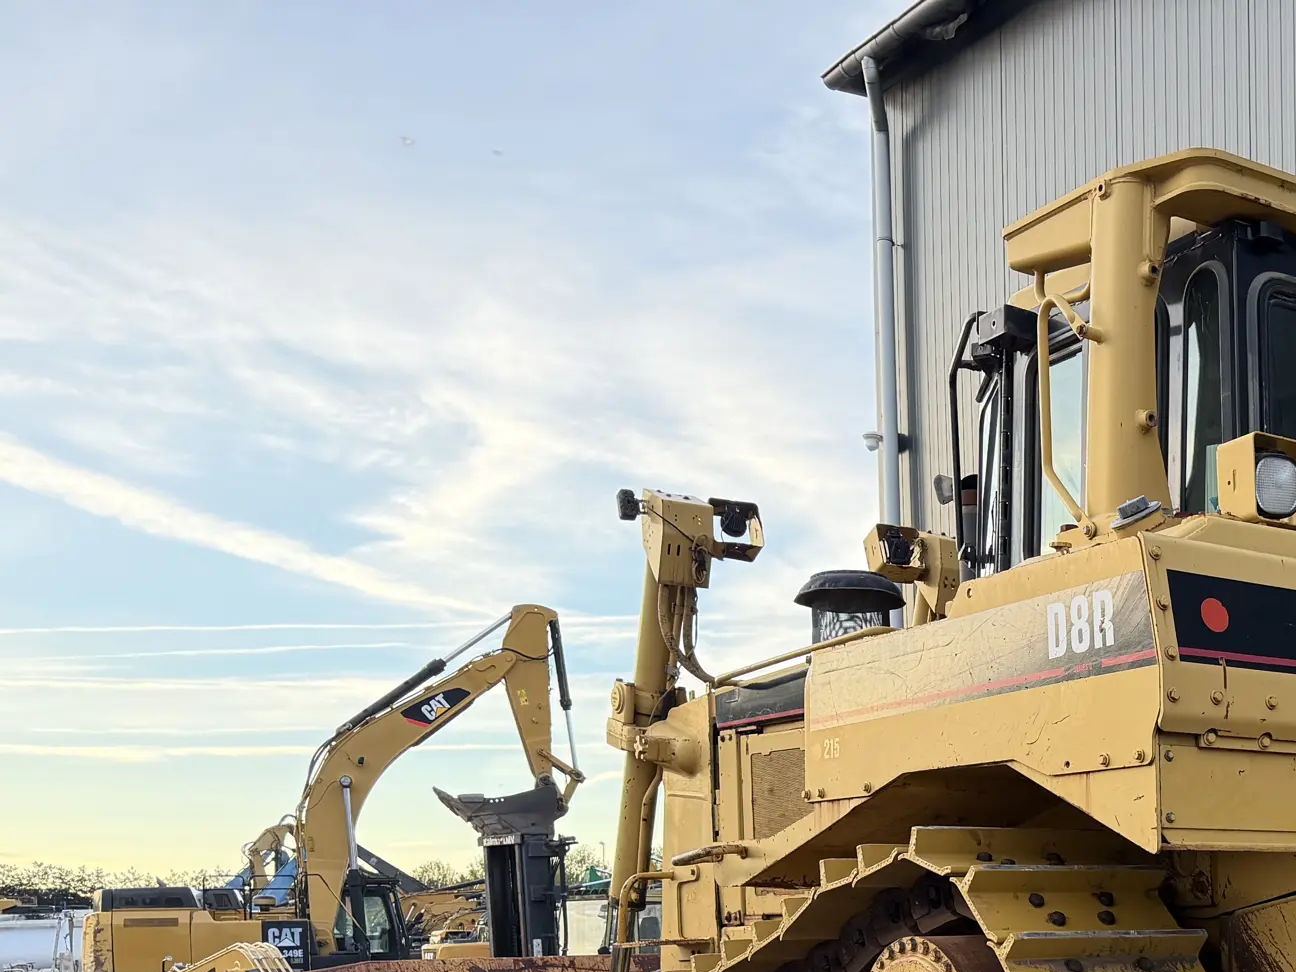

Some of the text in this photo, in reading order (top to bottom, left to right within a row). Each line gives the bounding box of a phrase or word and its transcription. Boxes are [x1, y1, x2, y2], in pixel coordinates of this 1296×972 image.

[1046, 589, 1115, 660] D8R
[421, 693, 451, 720] CAT
[824, 737, 840, 759] 215
[267, 927, 303, 947] CAT
[282, 949, 304, 958] 349E
